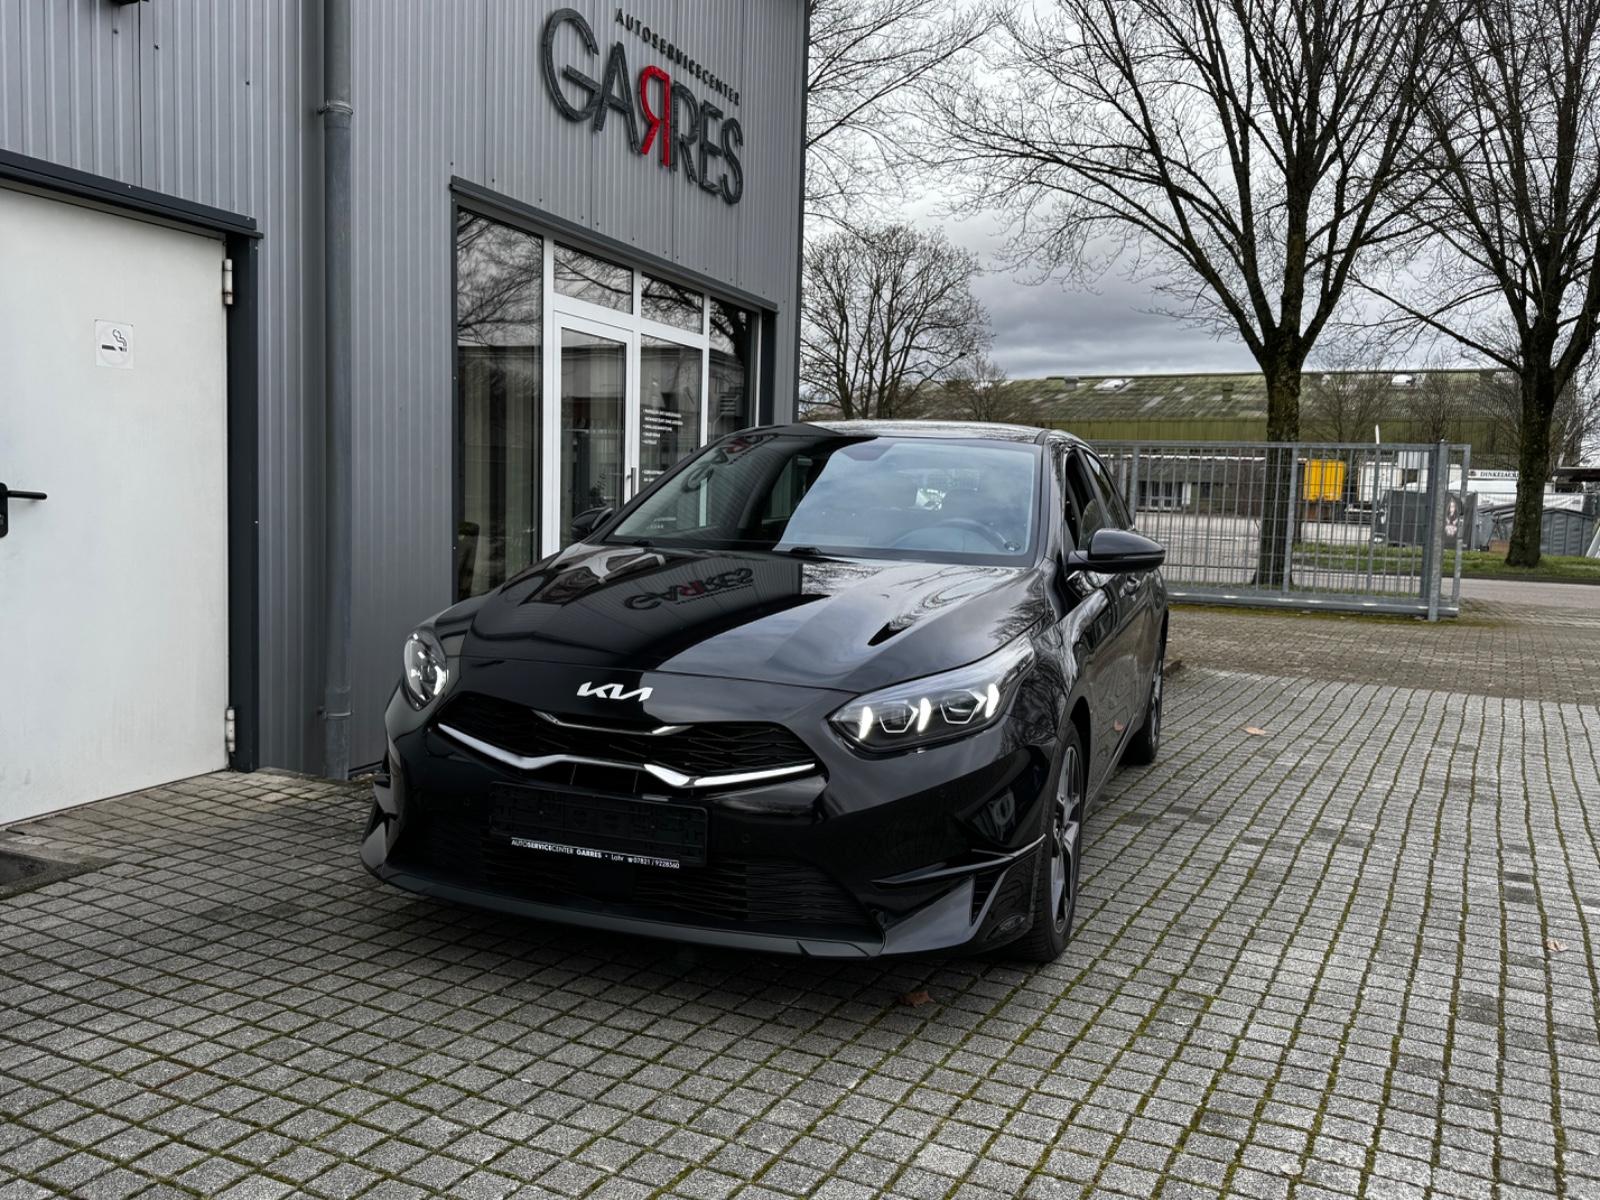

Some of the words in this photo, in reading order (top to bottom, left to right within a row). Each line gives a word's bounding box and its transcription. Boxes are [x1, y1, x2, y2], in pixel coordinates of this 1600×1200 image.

[539, 7, 744, 204] GARRES
[615, 8, 740, 106] AUTOSERVICECENTER
[511, 839, 573, 854] AUTOSERVICECENTER
[576, 848, 602, 859] GARRES
